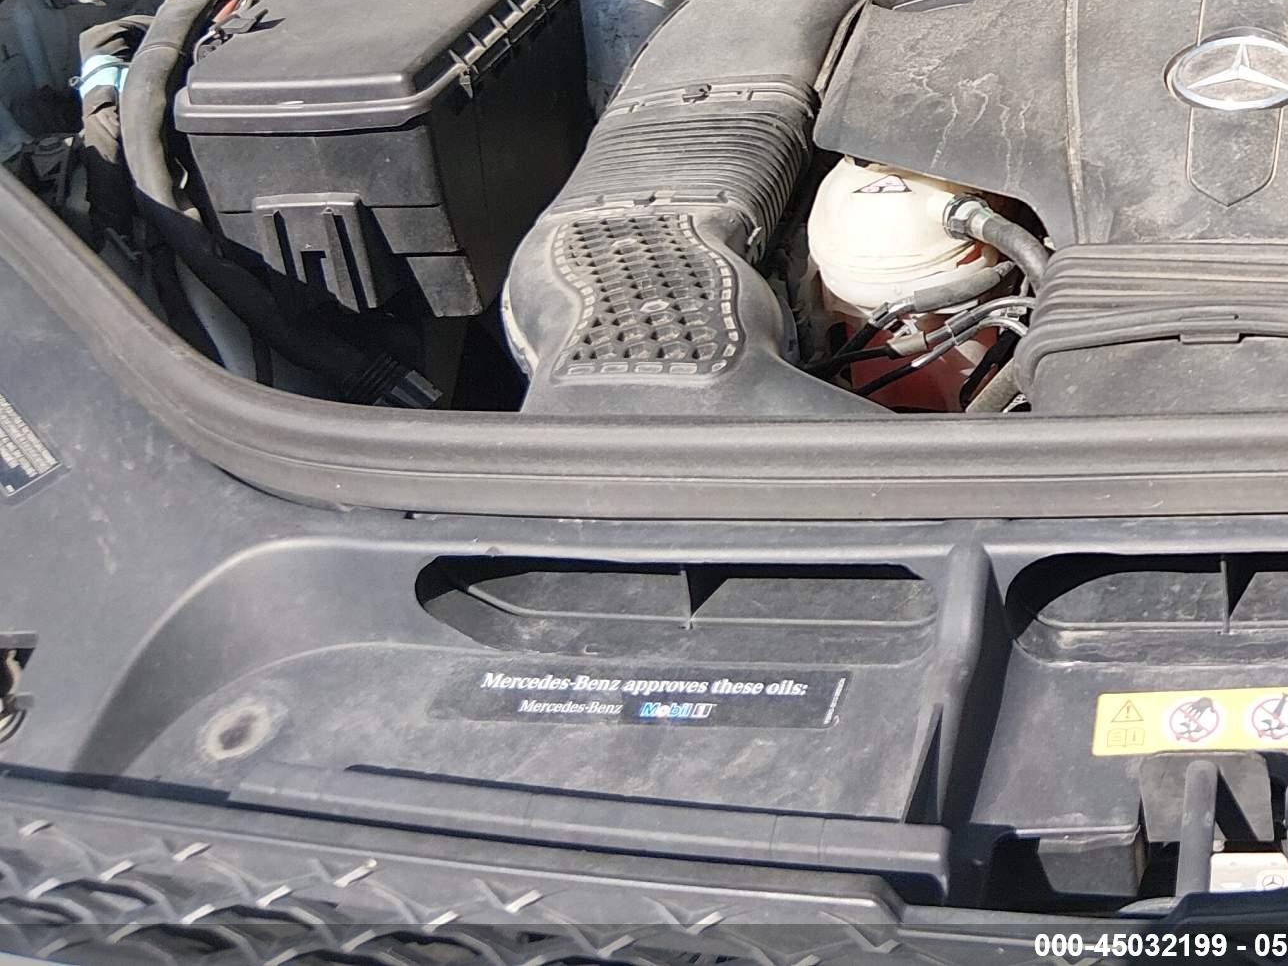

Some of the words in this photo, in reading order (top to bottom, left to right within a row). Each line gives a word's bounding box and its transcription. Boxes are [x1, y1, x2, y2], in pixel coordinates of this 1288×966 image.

[481, 672, 621, 691] Mercedes-Benz
[623, 678, 708, 697] approves
[711, 678, 764, 695] these
[766, 680, 809, 696] oils:
[518, 699, 623, 714] Mercedes-Benz
[640, 702, 692, 719] Mobil
